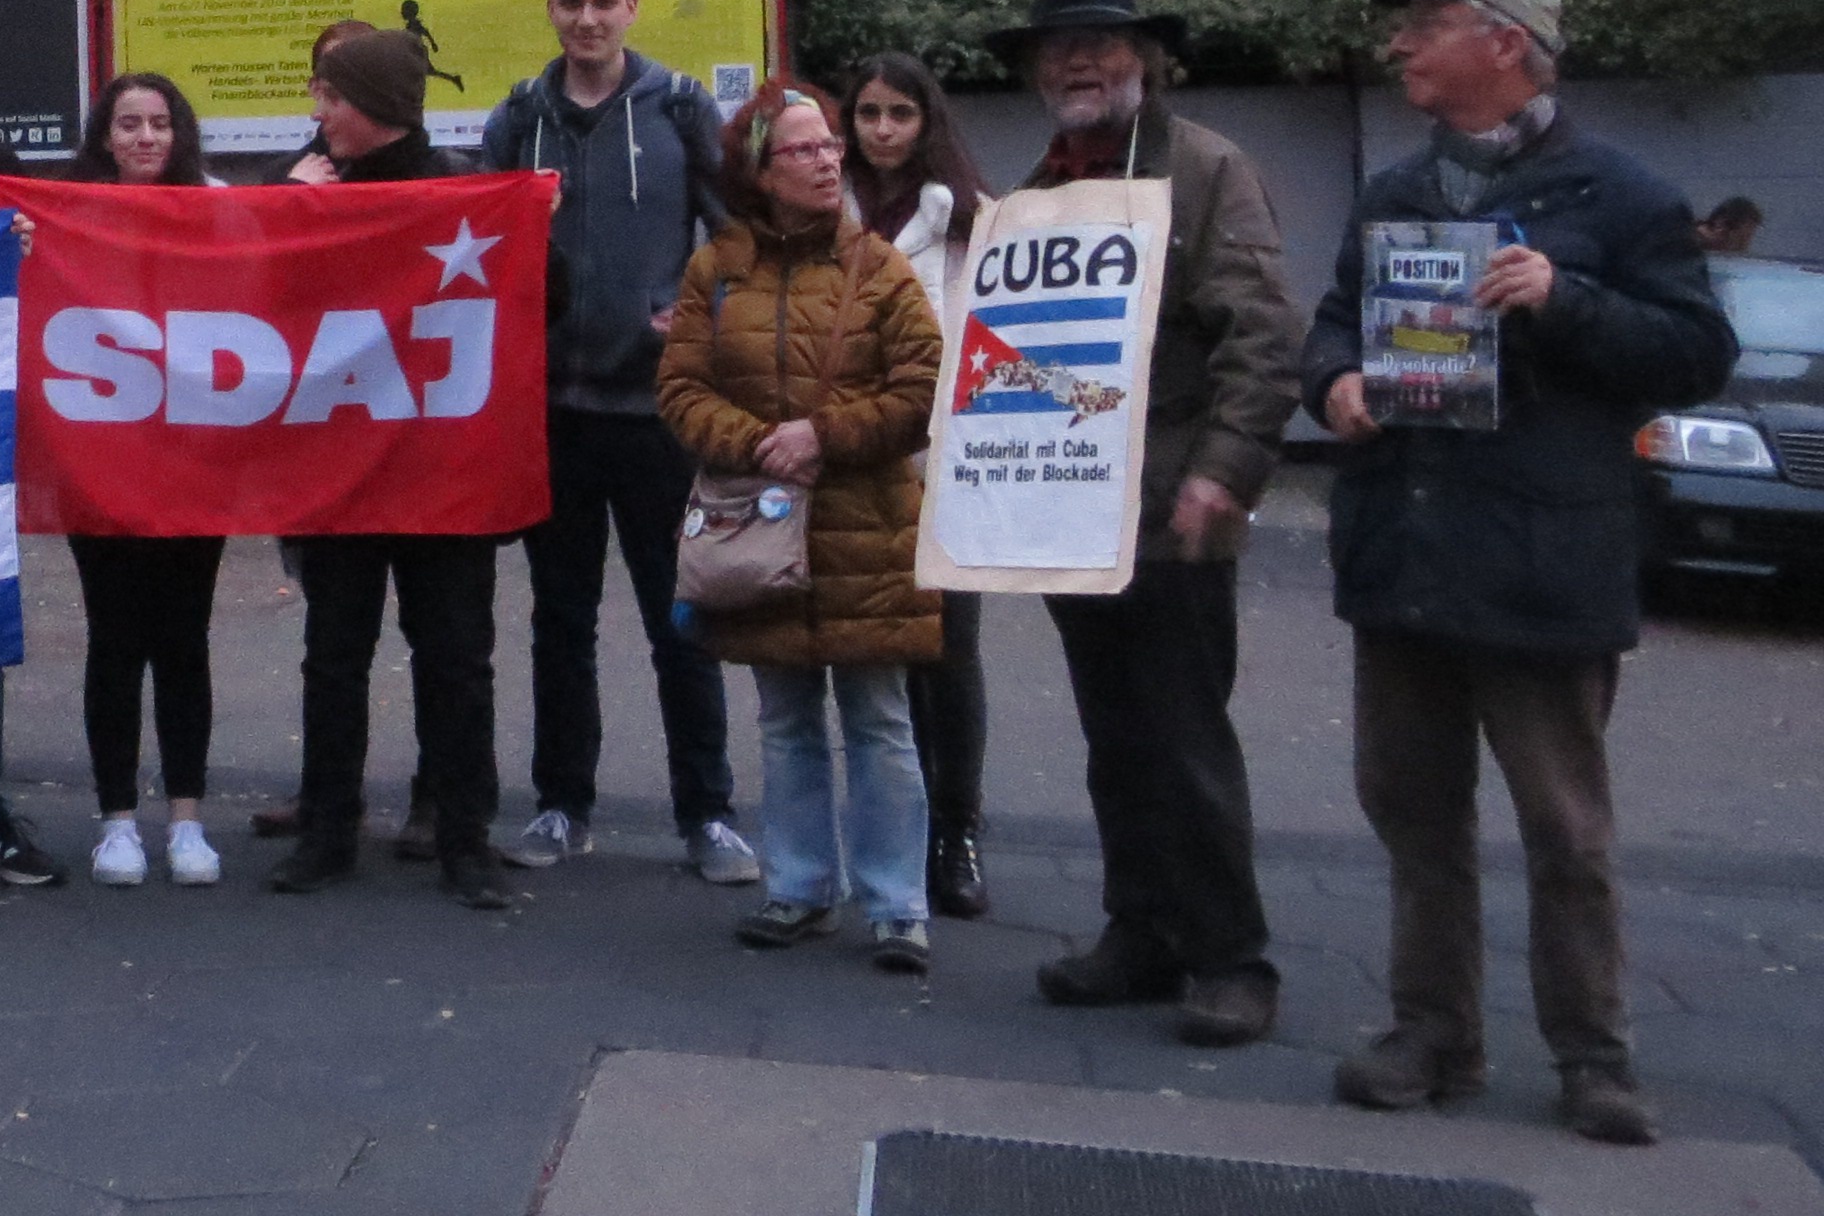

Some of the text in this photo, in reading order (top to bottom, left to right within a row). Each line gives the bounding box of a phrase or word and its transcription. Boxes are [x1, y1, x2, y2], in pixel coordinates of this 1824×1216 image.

[975, 234, 1138, 297] CUBA
[1393, 259, 1461, 281] POSITION
[42, 298, 496, 426] SDAJ
[964, 439, 1098, 460] Solidarität mit Cuba
[954, 463, 1112, 486] Weg mit der Blockade!
